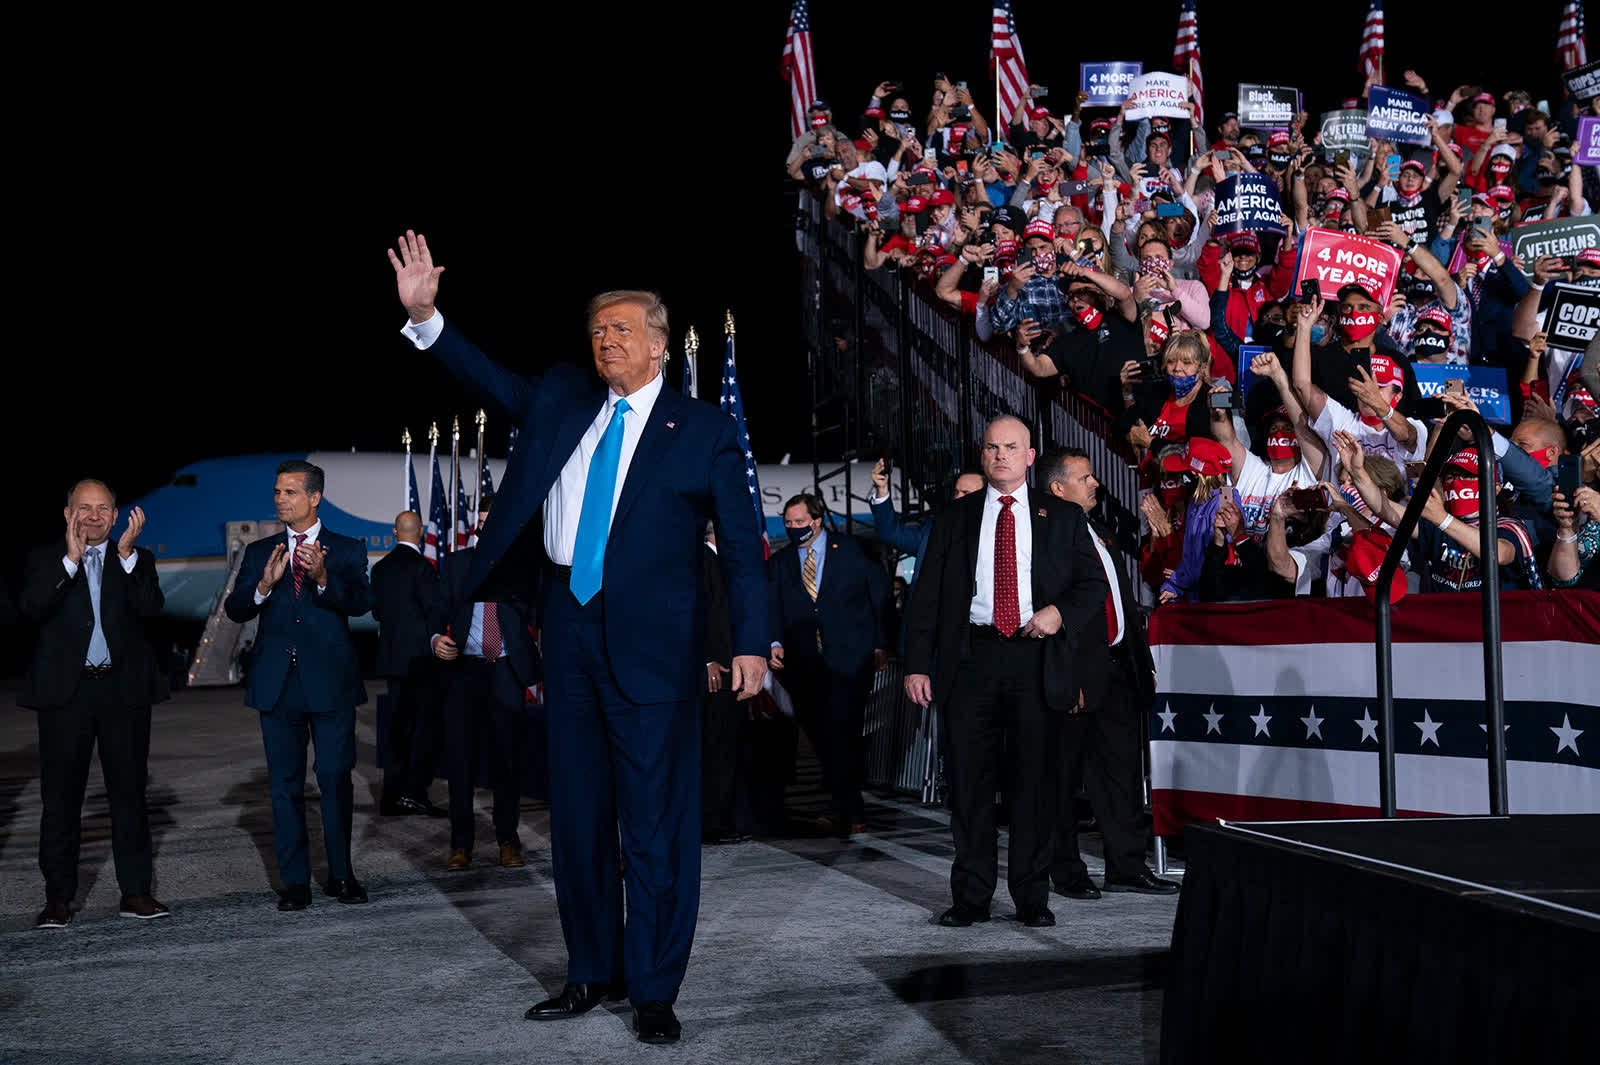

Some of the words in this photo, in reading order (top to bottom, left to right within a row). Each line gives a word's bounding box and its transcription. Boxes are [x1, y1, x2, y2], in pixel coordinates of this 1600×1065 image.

[1089, 73, 1098, 83] 4
[1100, 73, 1134, 83] MORE
[1145, 79, 1169, 87] MAKE
[1568, 72, 1596, 92] COPS
[1090, 85, 1129, 96] YEARS
[1131, 88, 1185, 101] AMERICA
[1248, 90, 1274, 102] Black
[1135, 100, 1157, 109] REAT
[1160, 100, 1181, 109] AGA
[1262, 101, 1292, 112] Voices
[1387, 98, 1413, 109] MAKE
[1370, 105, 1429, 124] AMERICA
[1329, 123, 1367, 136] VETERA
[1369, 119, 1398, 132] GREAT
[1399, 124, 1429, 136] AGAIN
[1271, 154, 1290, 162] MAG
[1235, 184, 1267, 194] MAKE
[1216, 195, 1282, 213] AMERICA
[1216, 211, 1251, 225] GREAT
[1526, 233, 1597, 259] VETERANS
[1317, 247, 1331, 261] 4
[1336, 248, 1389, 278] MORE
[1151, 324, 1167, 340] MA
[1558, 325, 1588, 337] FOR
[1371, 358, 1389, 366] ERICA
[1417, 382, 1500, 398] Woers
[1464, 580, 1482, 588] GREA
